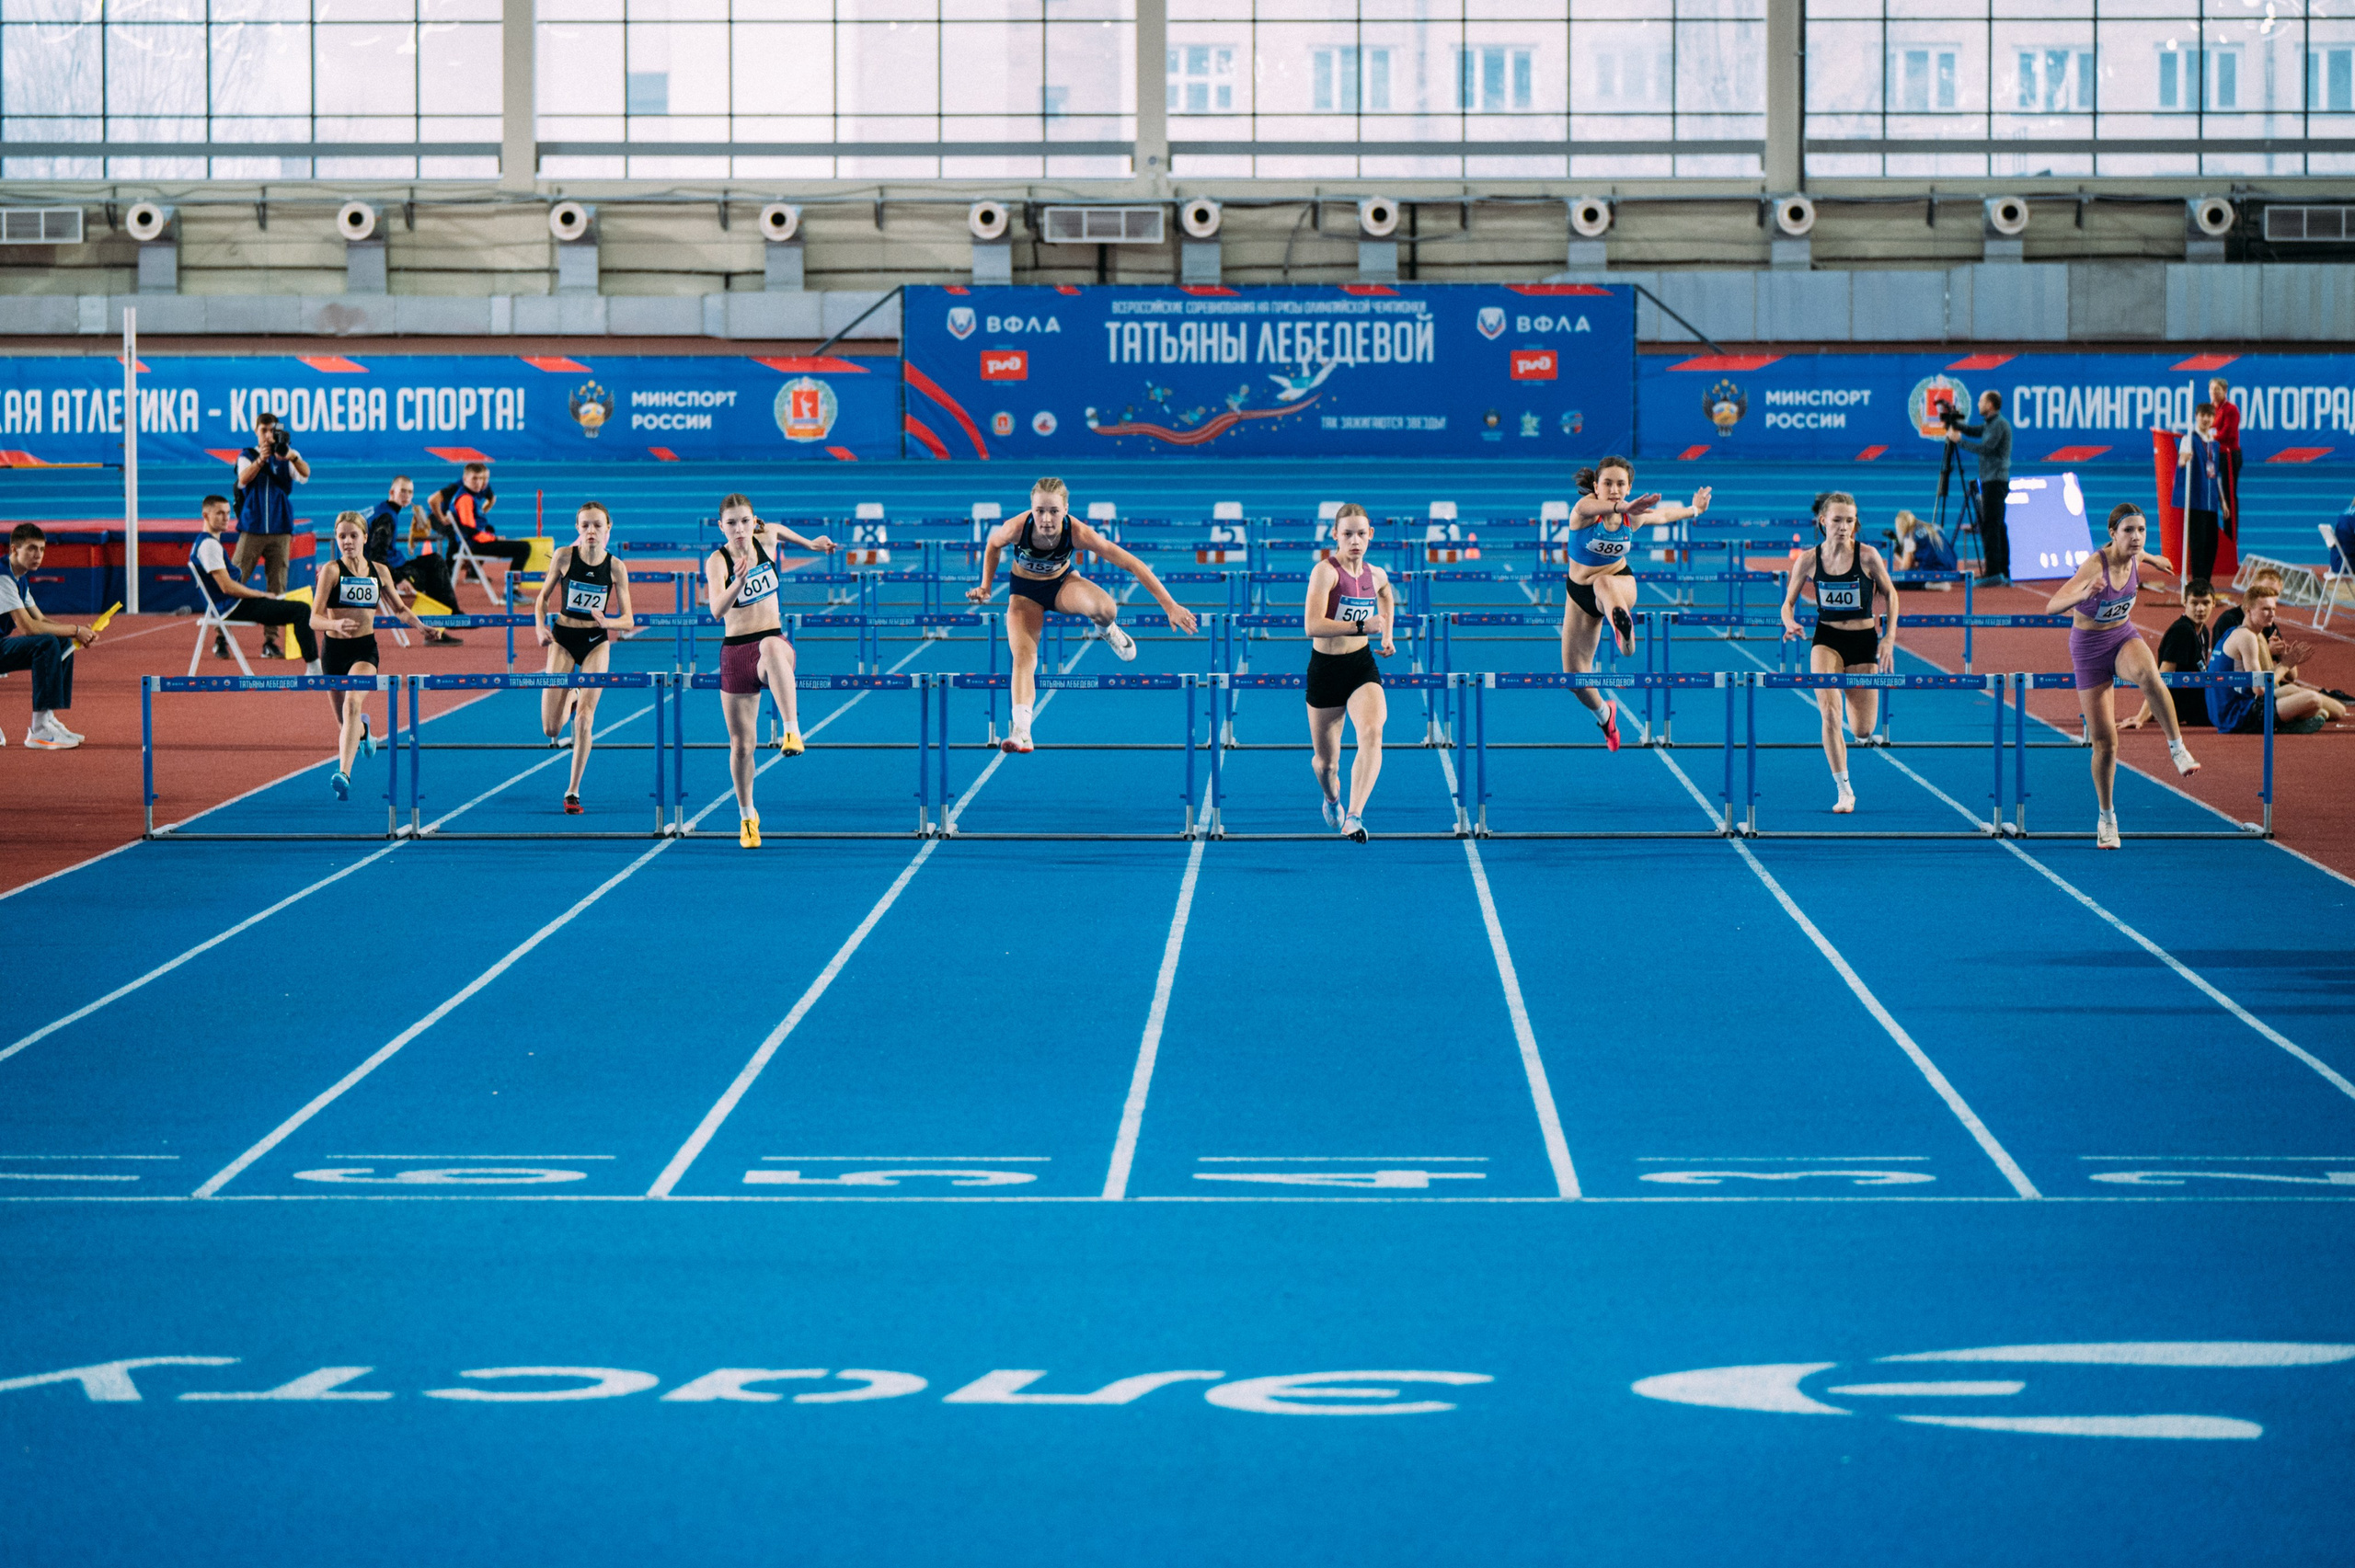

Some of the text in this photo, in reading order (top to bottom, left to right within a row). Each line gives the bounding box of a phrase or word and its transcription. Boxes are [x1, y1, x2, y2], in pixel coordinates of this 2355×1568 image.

[986, 315, 1061, 333] ВФЛА
[1516, 315, 1591, 333] ВФЛА
[1105, 313, 1434, 368] ТАТЬЯНЫ ЛЕБЕДЕВОЙ
[631, 390, 737, 407] МИНСПОРТ
[1765, 389, 1872, 406] МИНСПОРТ
[0, 388, 42, 434] АЯ
[52, 388, 200, 433] АТЛЕИКА
[396, 386, 525, 432] СПОРТА!
[2229, 386, 2355, 432] ОЛГОГРА
[631, 413, 712, 430] РОССИИ
[1765, 412, 1846, 429] РОССИИ
[1594, 542, 1624, 555] 389
[346, 587, 373, 601] 608
[743, 575, 771, 597] 601
[572, 593, 602, 608] 472
[1825, 592, 1854, 605] 440
[1342, 608, 1369, 622] 502
[2102, 602, 2131, 618] 429
[239, 680, 265, 689] ТАТЬЯНЫ
[509, 678, 535, 687] ТАТЬЯНЫ
[1040, 679, 1065, 688] ТАТЬЯНЫ
[1575, 678, 1602, 686] ТАТЬЯНЫ
[1846, 677, 1872, 686] ТАТЬЯНЫ
[1191, 1170, 1488, 1188] 4
[1637, 1170, 1937, 1185] 3
